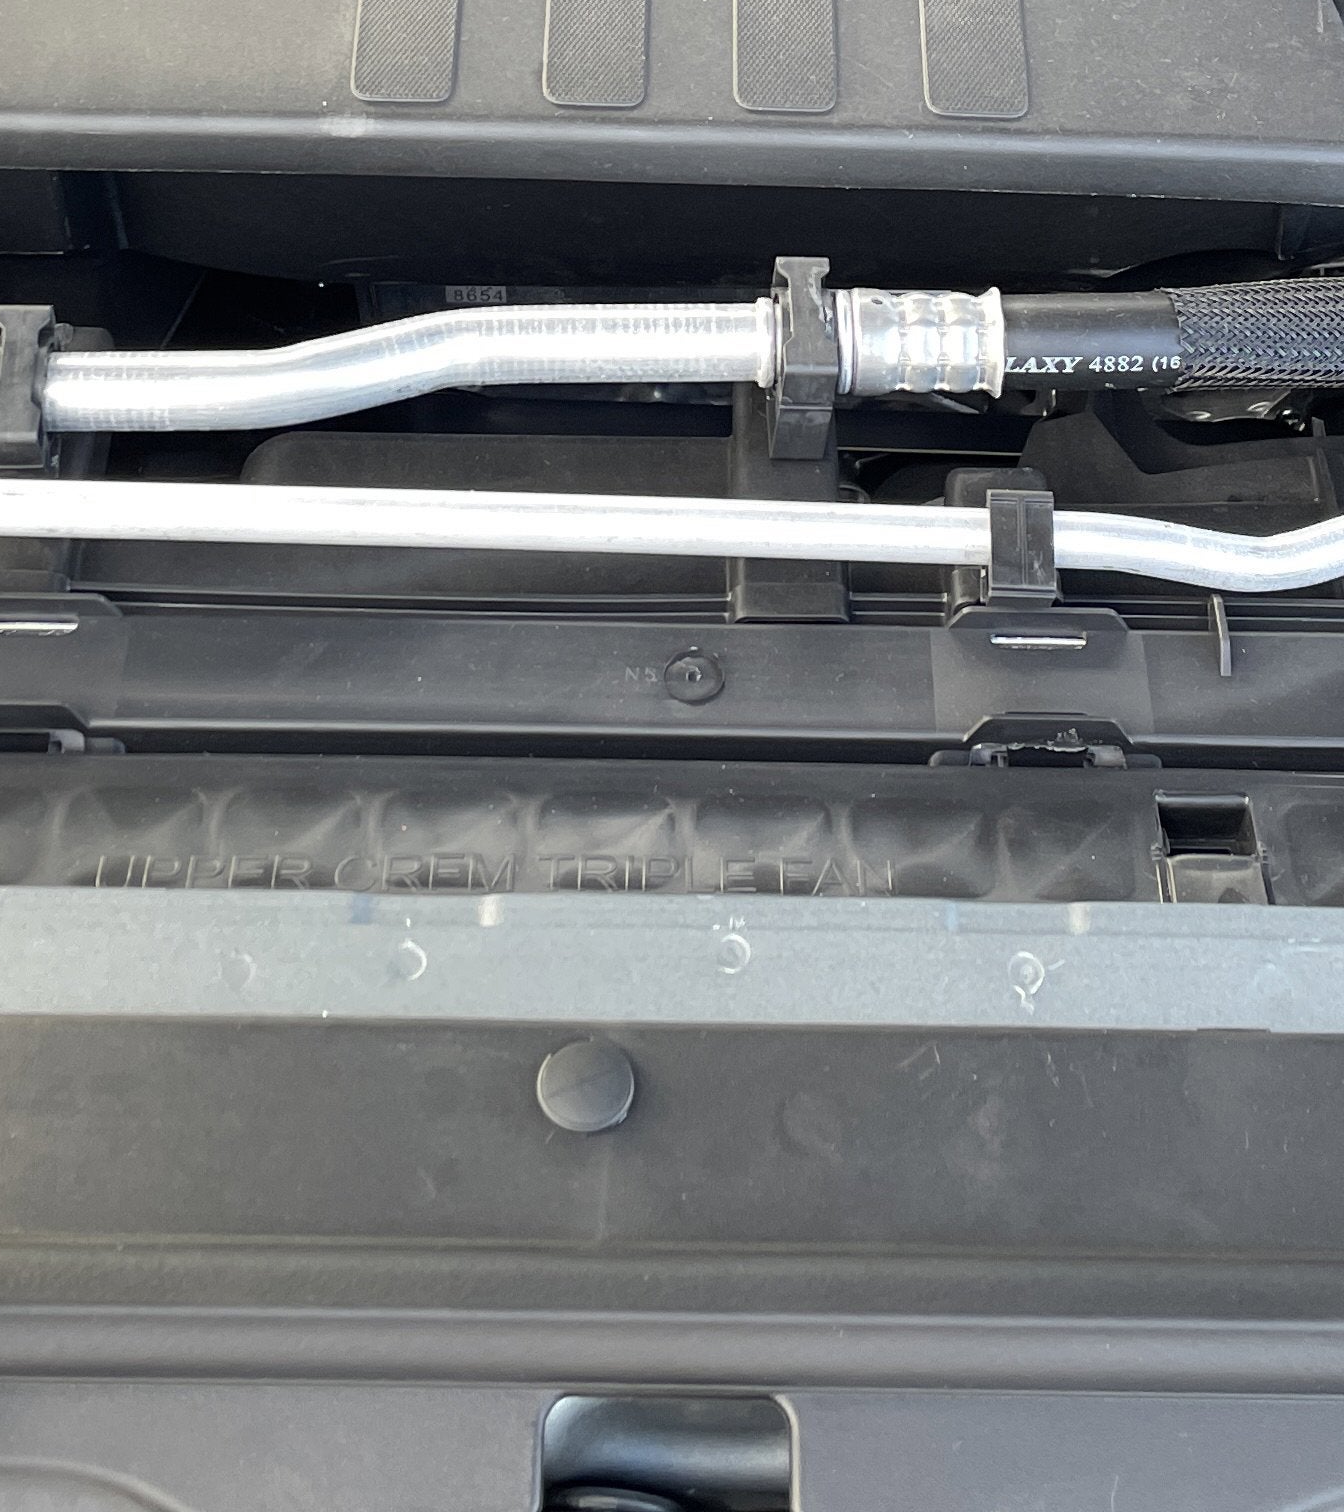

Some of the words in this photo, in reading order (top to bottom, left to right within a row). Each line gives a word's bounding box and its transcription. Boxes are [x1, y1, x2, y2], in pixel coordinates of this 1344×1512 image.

[1088, 355, 1144, 373] 4882
[94, 854, 313, 890] UPPER
[539, 854, 758, 893] TRIPLE
[779, 857, 893, 897] FAN
